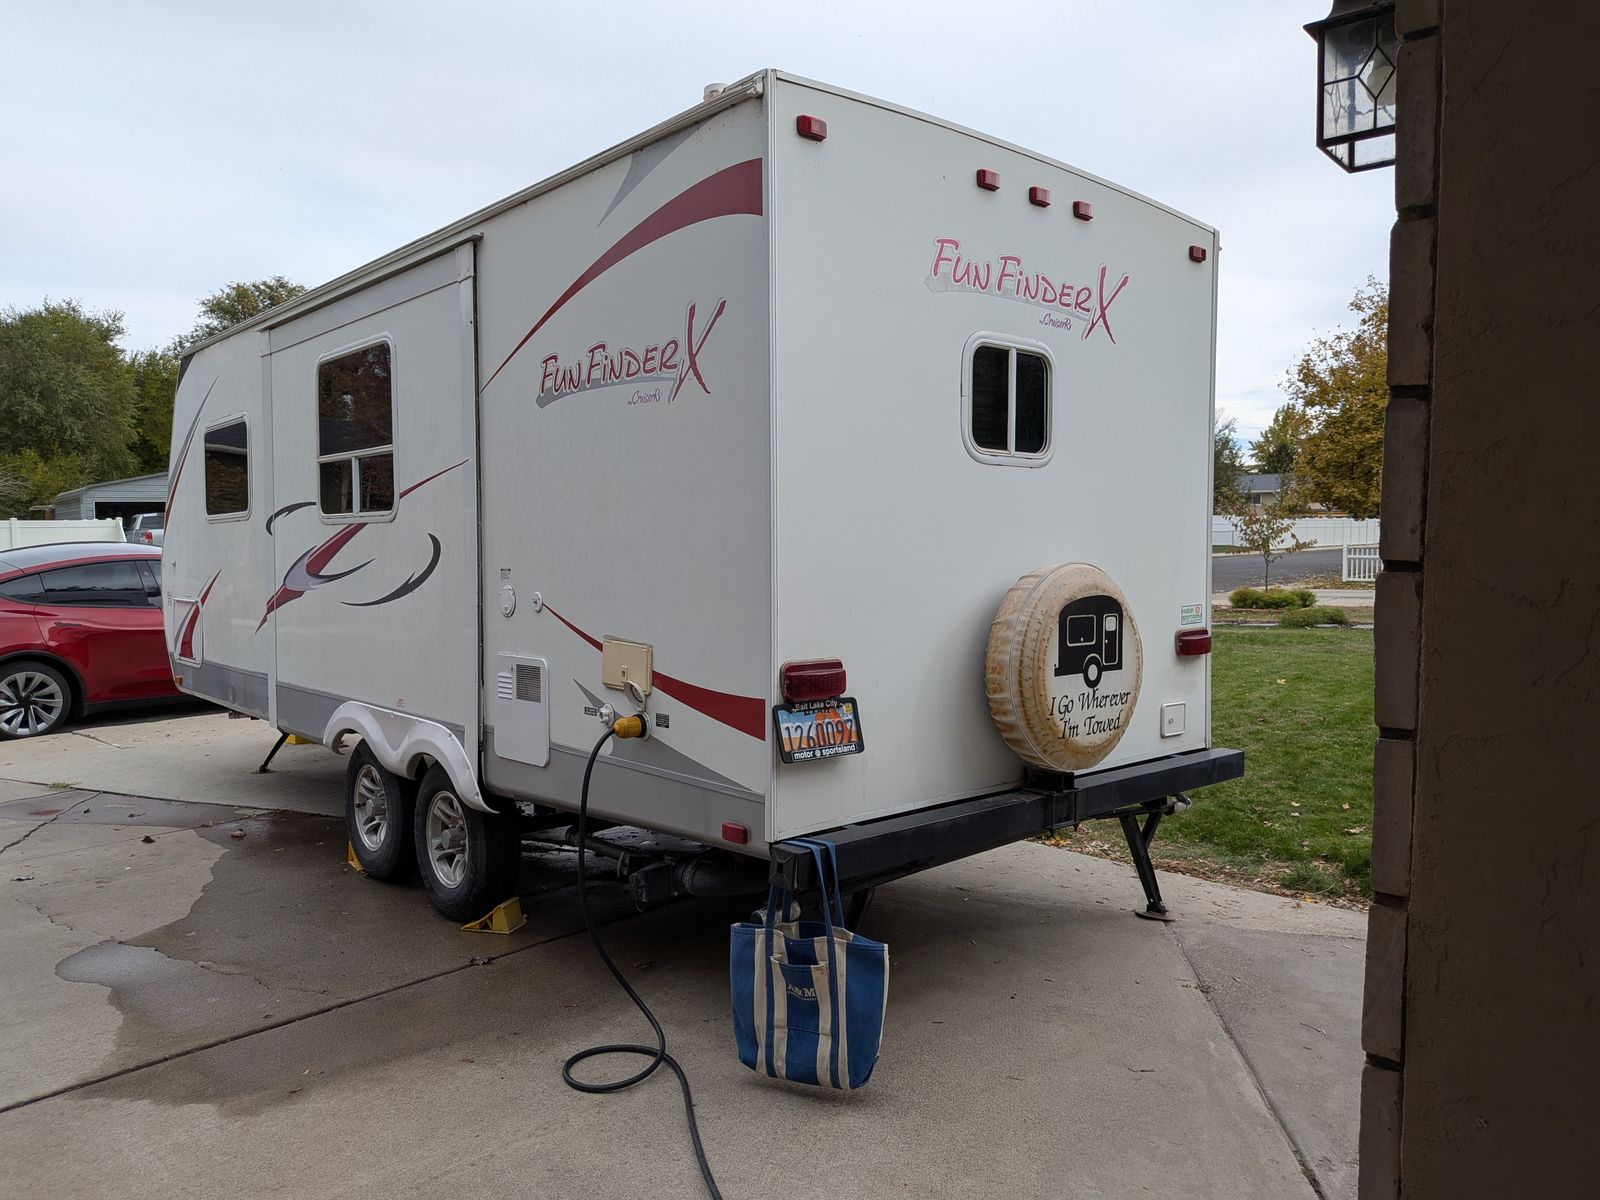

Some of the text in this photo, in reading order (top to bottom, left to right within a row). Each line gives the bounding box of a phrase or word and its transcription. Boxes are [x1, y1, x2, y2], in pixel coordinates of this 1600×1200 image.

[1084, 264, 1130, 345] X
[671, 299, 727, 402] X
[795, 702, 808, 711] Salt
[809, 701, 824, 709] Lake
[825, 699, 837, 708] City
[1048, 688, 1131, 721] I Go Wherever
[1058, 709, 1123, 740] I'm Towed
[794, 744, 856, 760] motor sportsland
